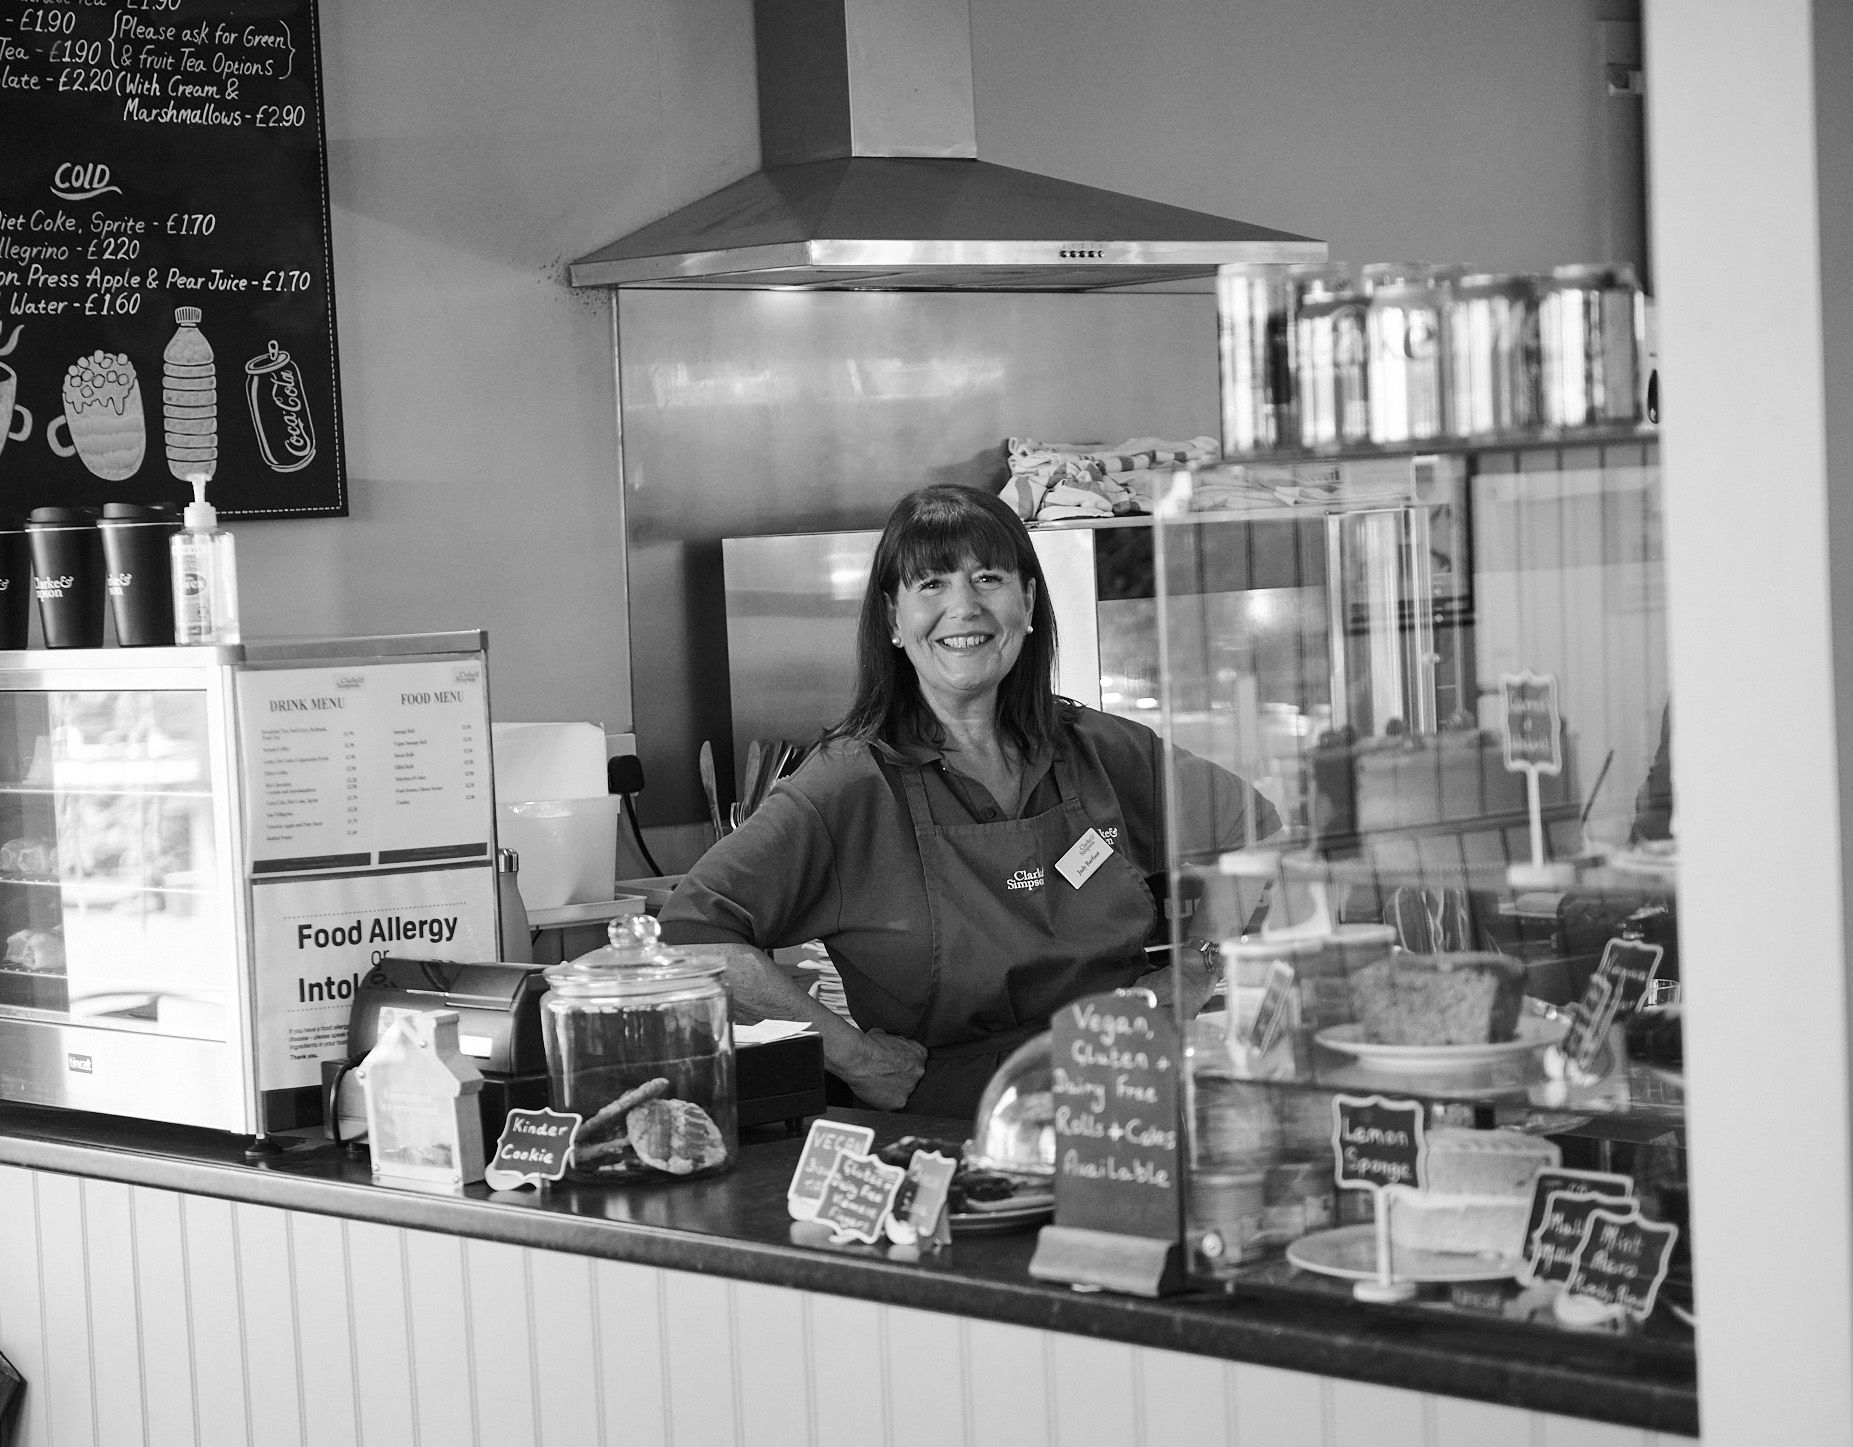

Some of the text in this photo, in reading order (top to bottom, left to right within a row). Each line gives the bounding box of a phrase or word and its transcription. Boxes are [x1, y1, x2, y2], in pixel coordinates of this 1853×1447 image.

[20, 9, 76, 34] £1.90
[120, 15, 287, 49] Please ask for Green
[49, 39, 101, 64] £1.90
[121, 45, 133, 66] &
[180, 48, 207, 72] Tea
[213, 53, 274, 79] Options
[59, 68, 112, 91] £2.20
[168, 74, 220, 99] Cream
[225, 78, 239, 100] &
[124, 97, 242, 126] Marshmallows
[255, 105, 305, 127] £2.90
[54, 162, 110, 189] COLD
[90, 211, 145, 239] Sprite
[166, 213, 216, 235] £1.70
[28, 263, 79, 288] Press
[86, 268, 141, 295] Apple
[147, 269, 159, 289] &
[166, 268, 205, 291] Pear
[208, 270, 248, 291] Juice
[263, 271, 311, 292] £1.70
[10, 292, 68, 315] Water
[85, 292, 141, 316] £1.60
[269, 697, 345, 712] DRINK MENU
[400, 690, 464, 706] FOOD MENU
[298, 916, 457, 949] Food Allergy
[512, 1117, 569, 1137] Kinder
[1342, 1115, 1409, 1148] Lemon
[500, 1143, 554, 1165] Cookie
[1344, 1145, 1413, 1184] Sponge
[1063, 1148, 1171, 1188] Available
